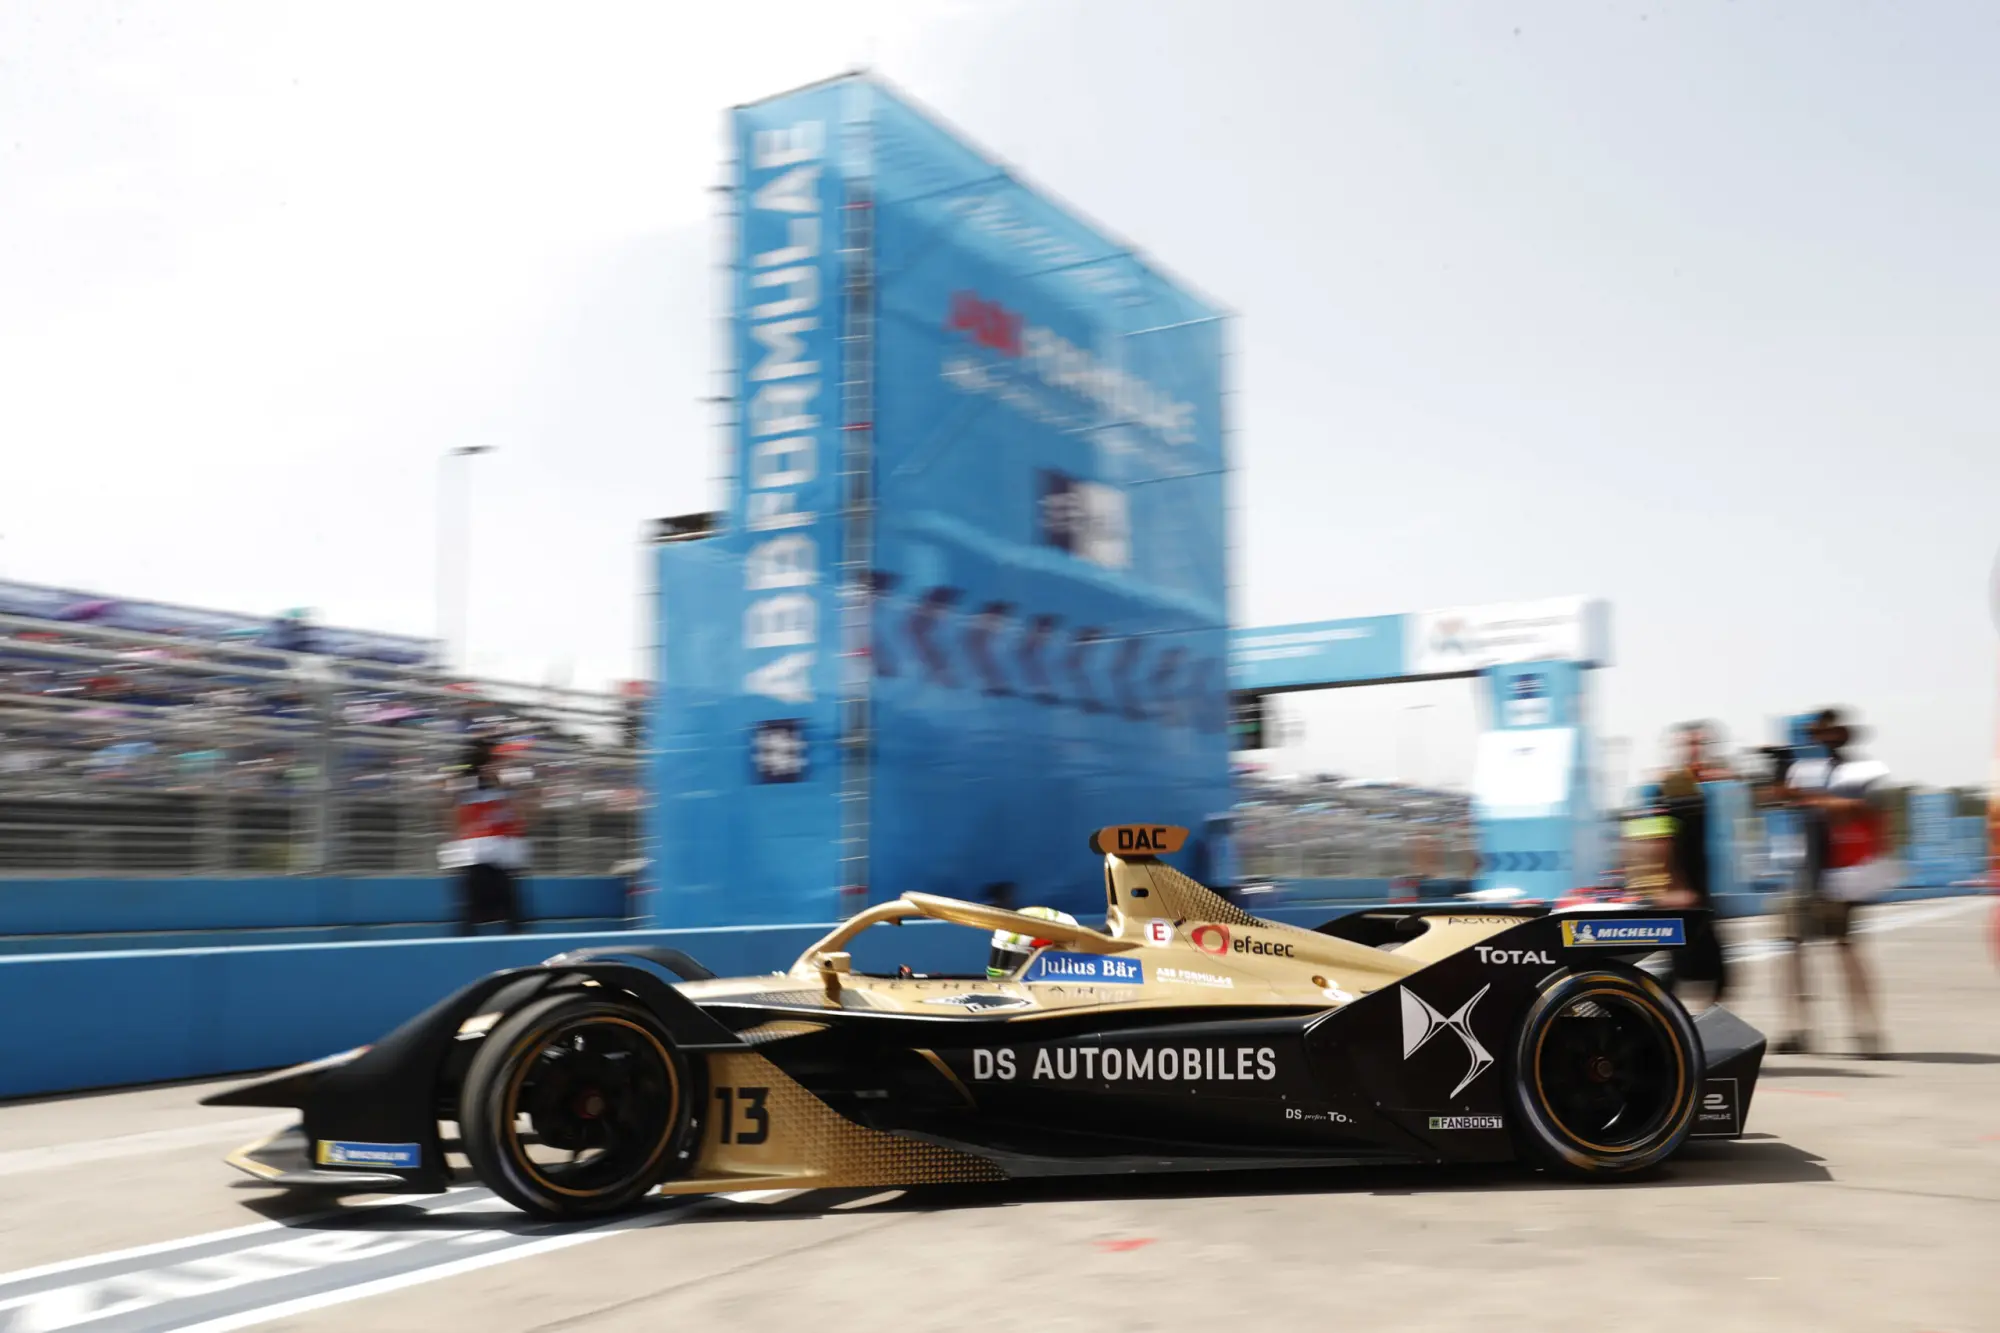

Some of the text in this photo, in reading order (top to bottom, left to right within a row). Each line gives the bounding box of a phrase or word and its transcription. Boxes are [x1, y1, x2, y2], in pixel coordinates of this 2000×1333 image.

[1118, 828, 1166, 850] DAC
[1152, 923, 1166, 941] E
[1597, 927, 1674, 938] MICHELIN
[1233, 936, 1295, 958] efacec
[1475, 946, 1556, 965] TOTAL
[1040, 957, 1138, 978] Julius Bär
[973, 1047, 1277, 1080] DS AUTOMOBILES
[714, 1087, 770, 1145] 13
[1285, 1108, 1302, 1119] DS
[1431, 1117, 1502, 1128] #FANBOOST
